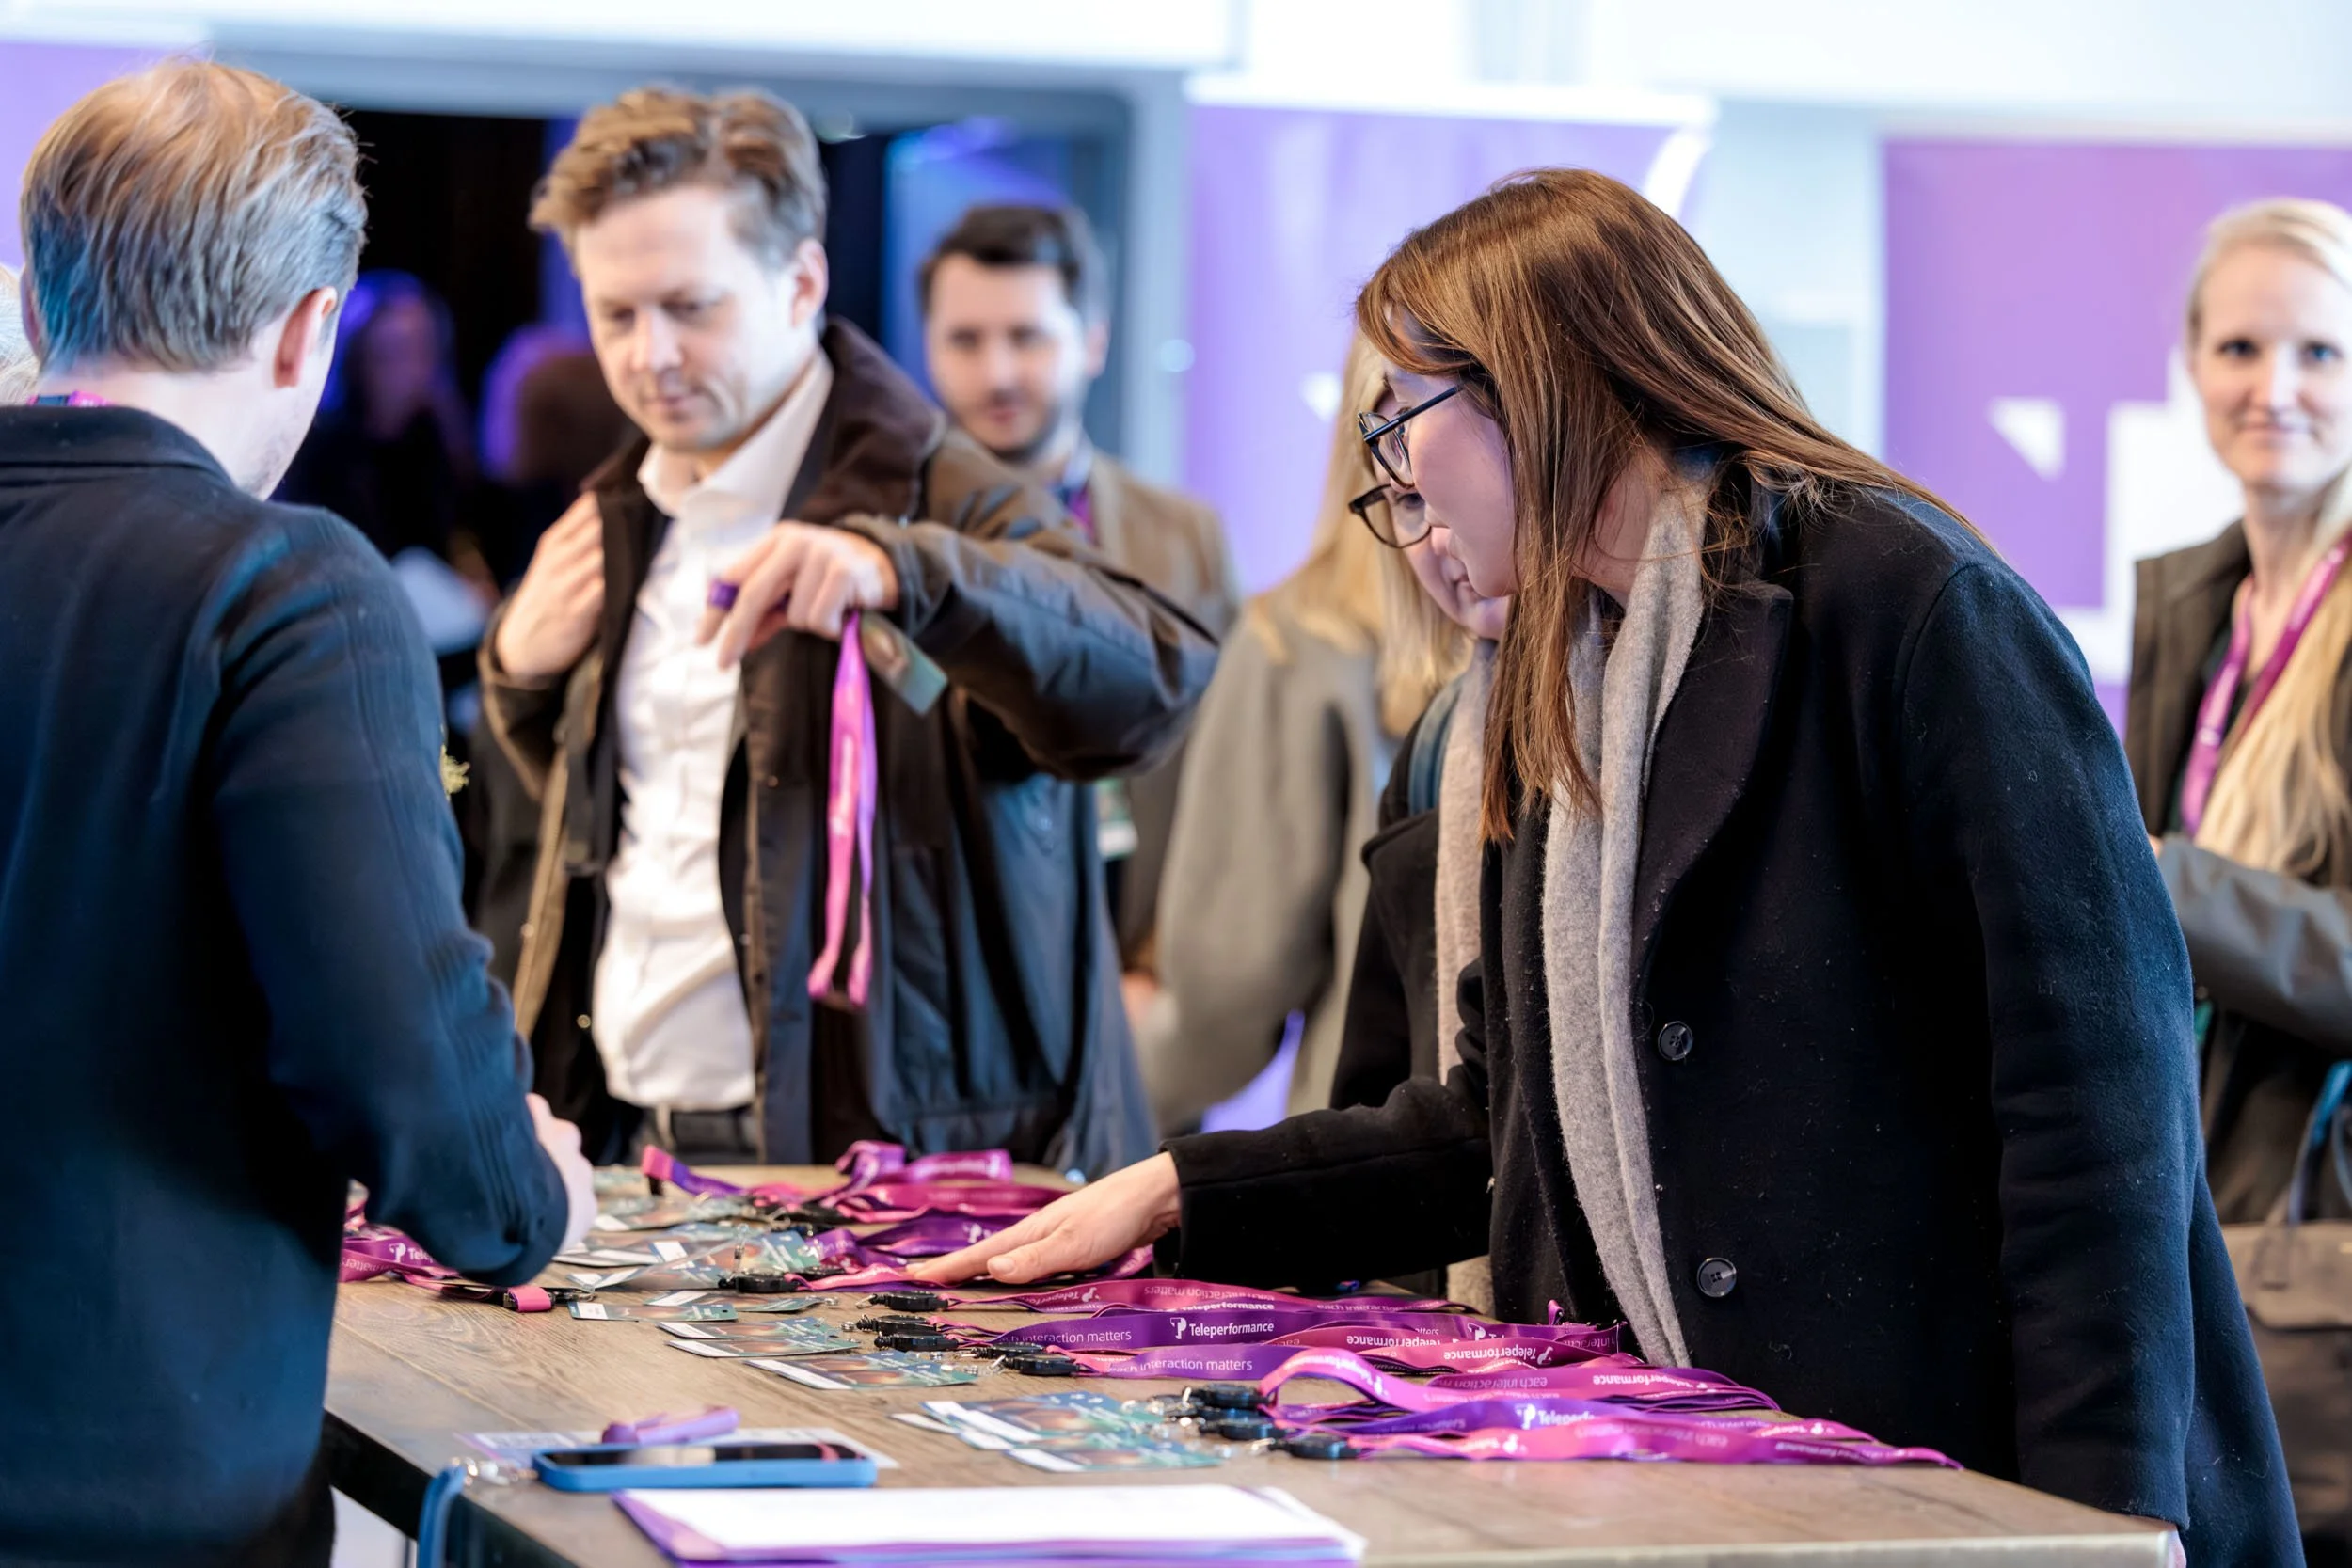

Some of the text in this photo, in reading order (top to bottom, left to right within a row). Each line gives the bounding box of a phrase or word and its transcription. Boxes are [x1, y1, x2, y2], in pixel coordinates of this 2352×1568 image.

[1144, 1286, 1185, 1298] matters
[1022, 1332, 1084, 1344] interaction
[1087, 1330, 1132, 1343] matters
[1188, 1323, 1275, 1339] Teleperformance
[1443, 1344, 1537, 1361] Teleperformance
[1139, 1357, 1204, 1371] interaction
[1205, 1358, 1253, 1371] matters
[1520, 1376, 1548, 1389] each
